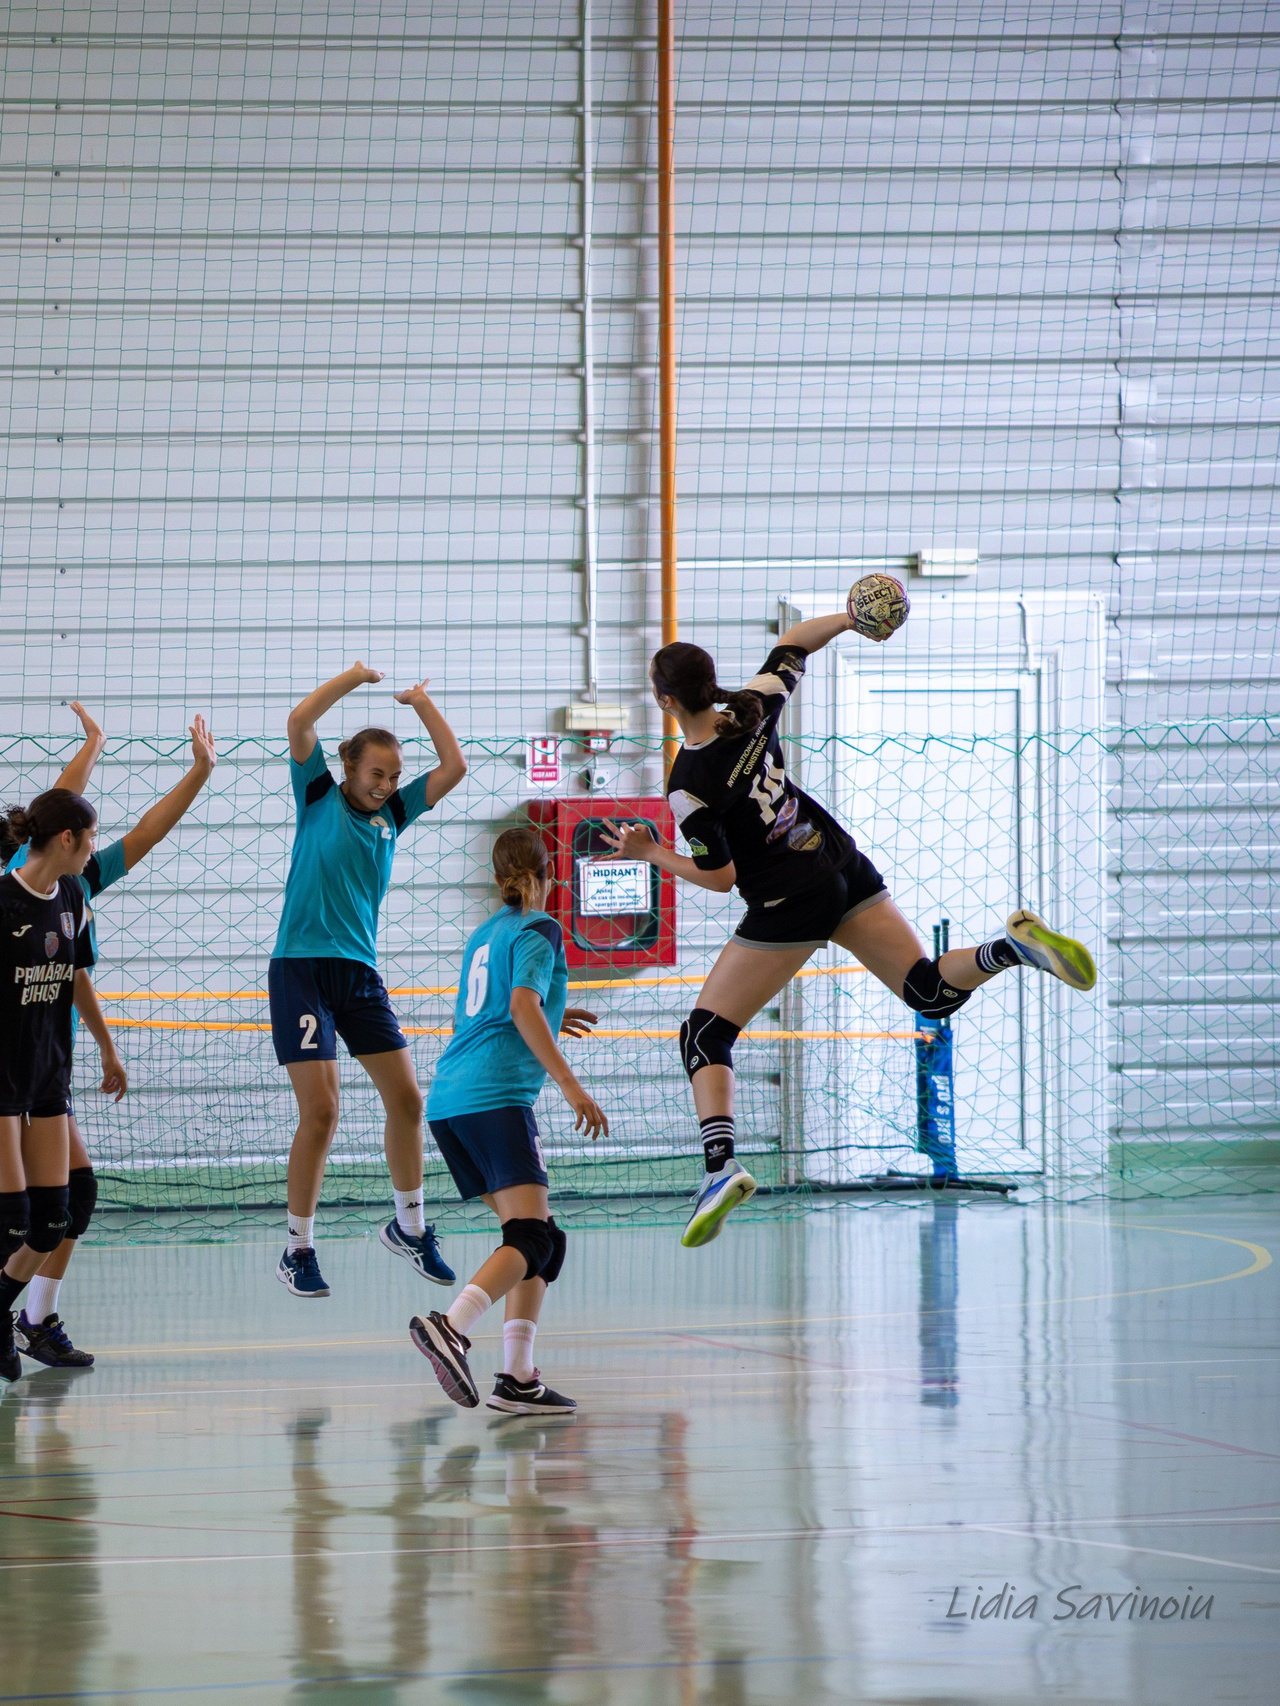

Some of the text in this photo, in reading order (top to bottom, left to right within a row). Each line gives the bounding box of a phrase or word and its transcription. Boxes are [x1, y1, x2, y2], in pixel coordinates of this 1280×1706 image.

[856, 586, 892, 609] SELECT
[726, 737, 757, 788] INTERNATIONAL
[743, 734, 769, 775] CONSTRUCT
[593, 867, 638, 877] HIDRANT
[465, 943, 490, 1018] 6
[299, 1013, 318, 1050] 2
[533, 1134, 548, 1173] 6
